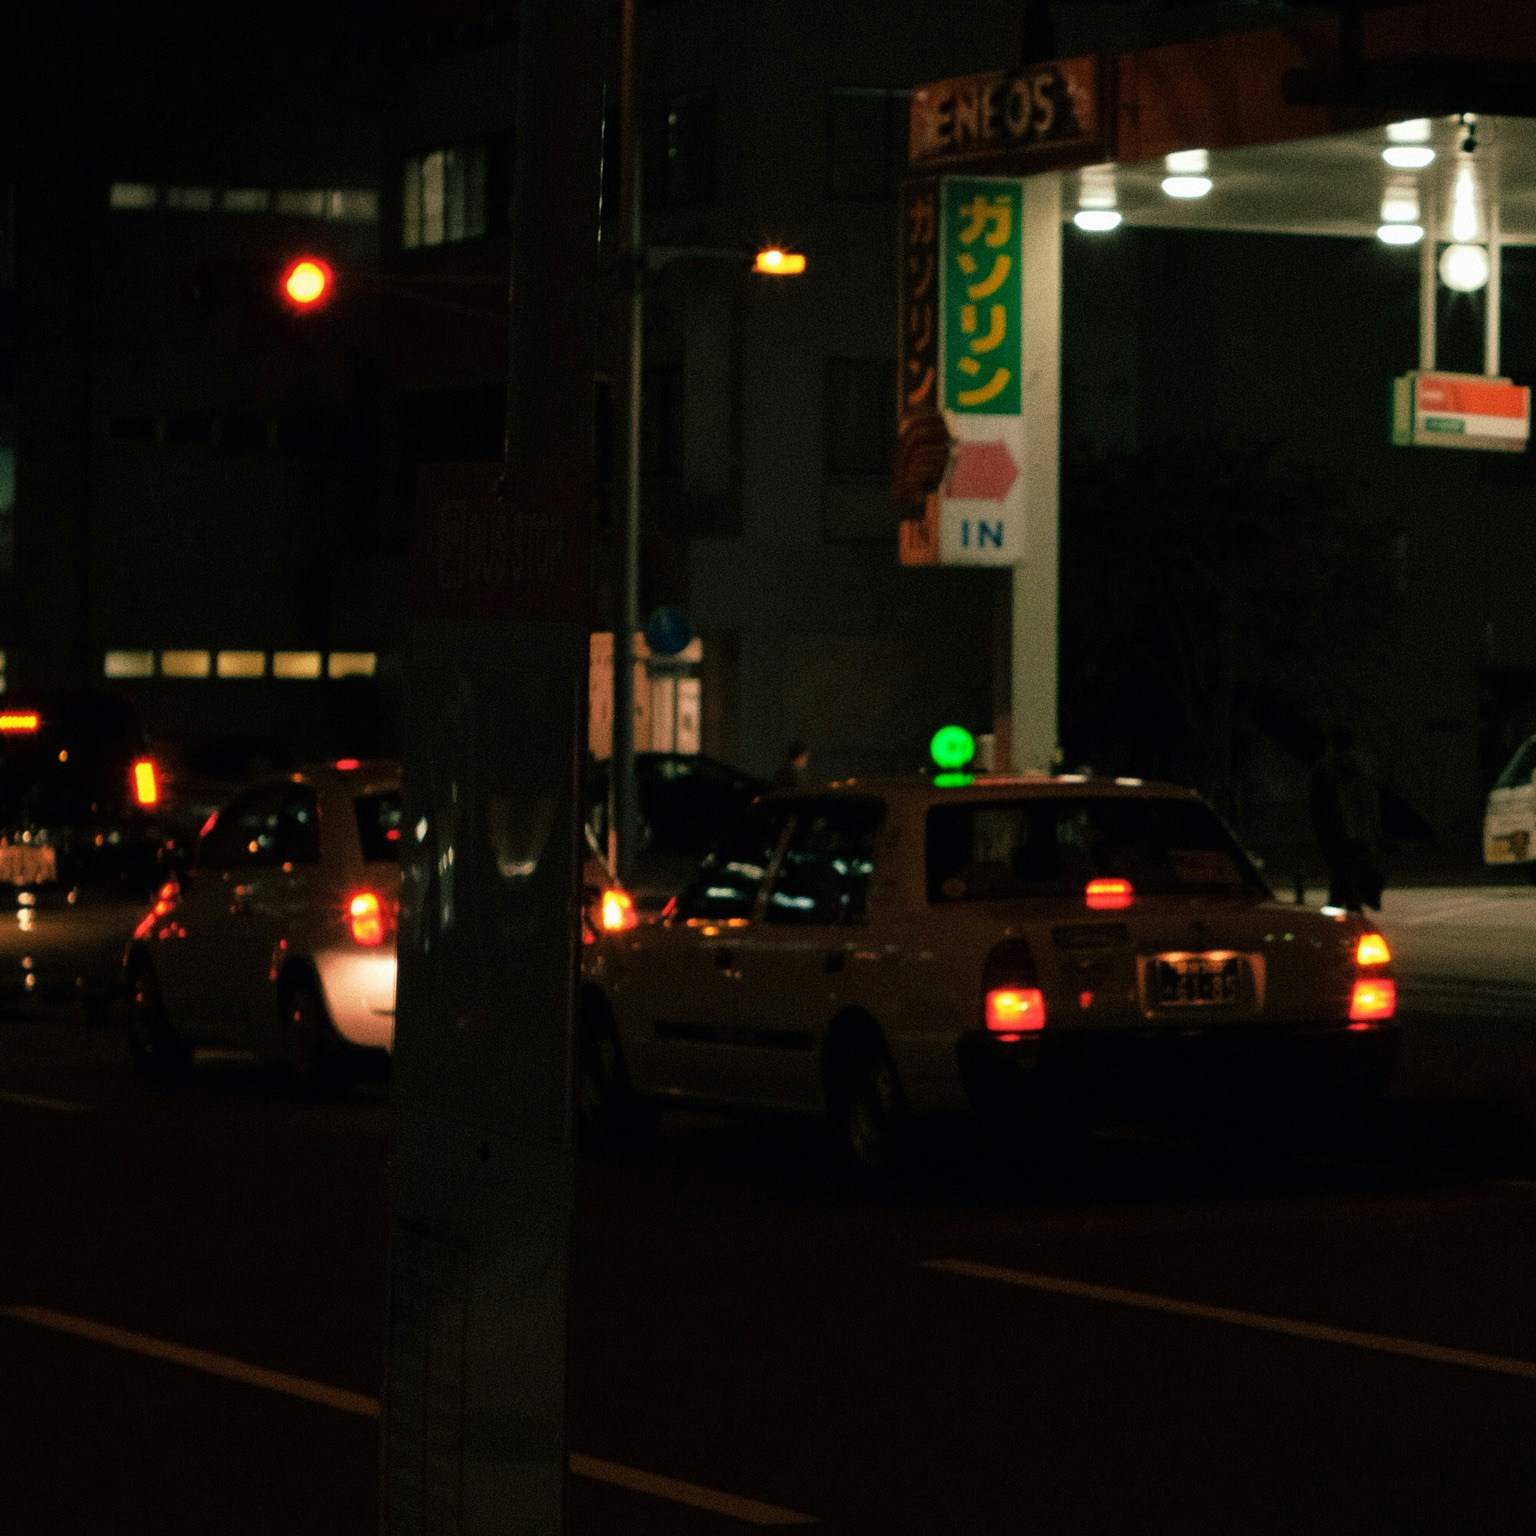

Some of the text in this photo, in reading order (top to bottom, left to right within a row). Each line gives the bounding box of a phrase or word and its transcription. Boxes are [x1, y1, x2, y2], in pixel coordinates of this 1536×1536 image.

[926, 73, 1056, 150] ENEOS
[957, 194, 1013, 407] ガソリン
[962, 519, 1004, 550] IN
